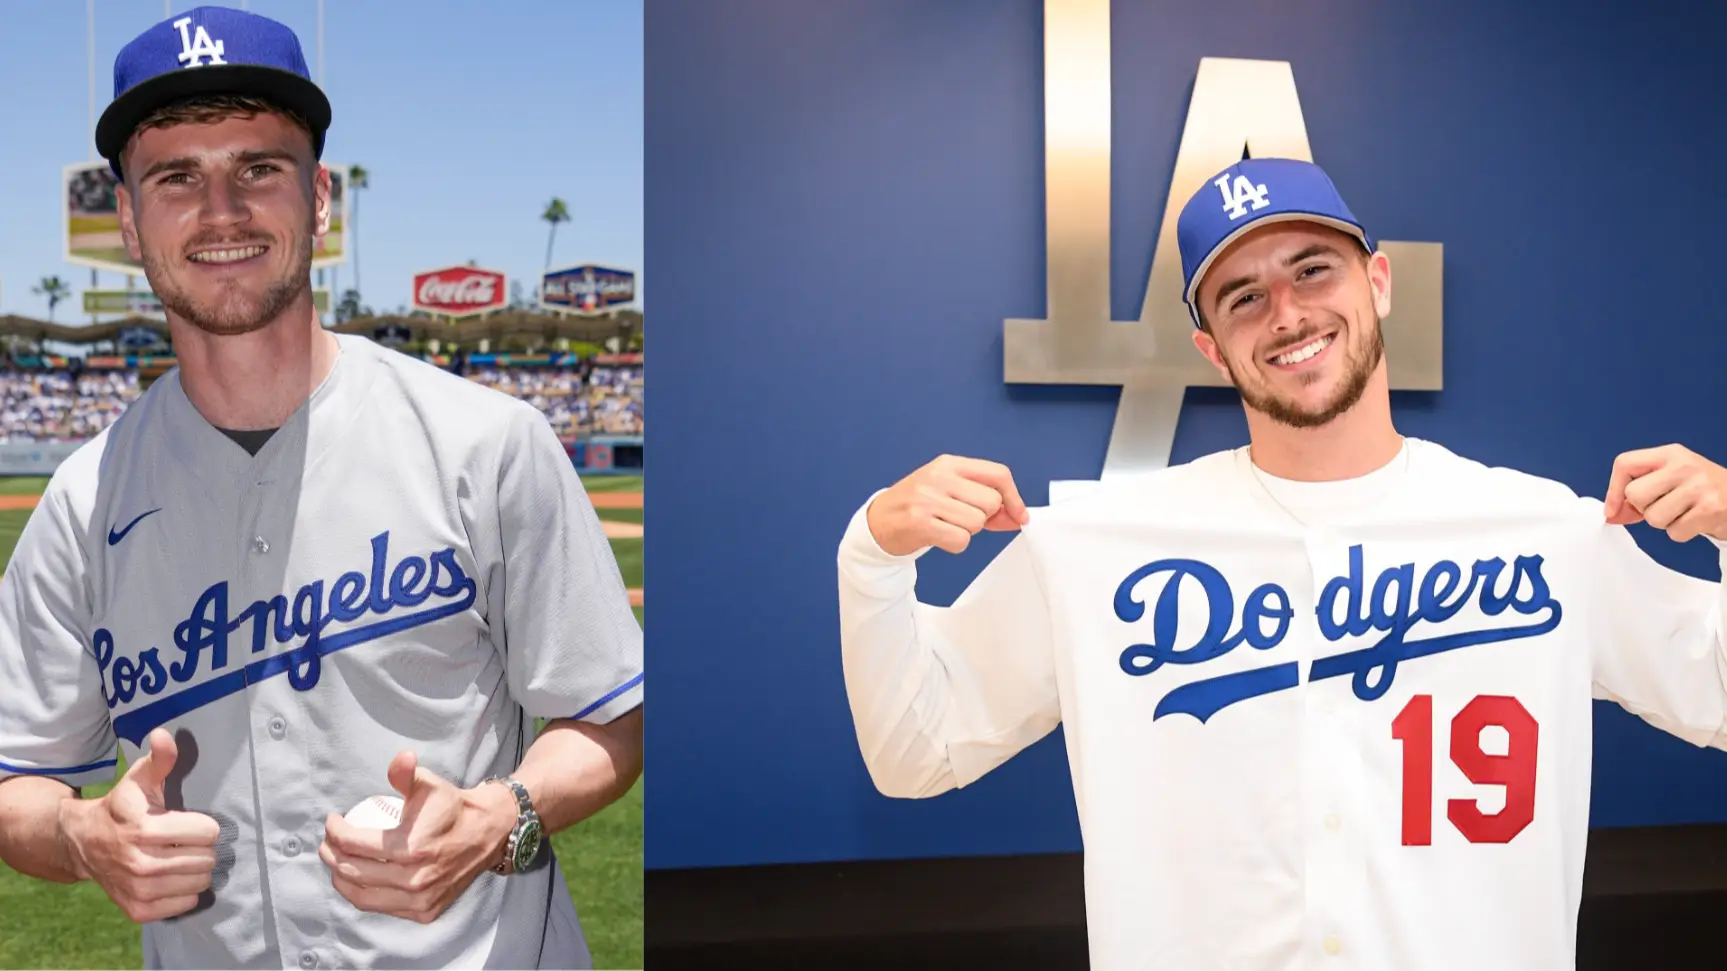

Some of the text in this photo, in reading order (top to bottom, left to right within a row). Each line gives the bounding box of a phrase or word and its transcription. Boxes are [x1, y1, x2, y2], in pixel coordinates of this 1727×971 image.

[173, 16, 228, 69] LA
[1214, 172, 1271, 221] LA
[169, 530, 477, 692] Angeles
[1113, 544, 1563, 703] Dodgers
[1391, 694, 1540, 846] 19
